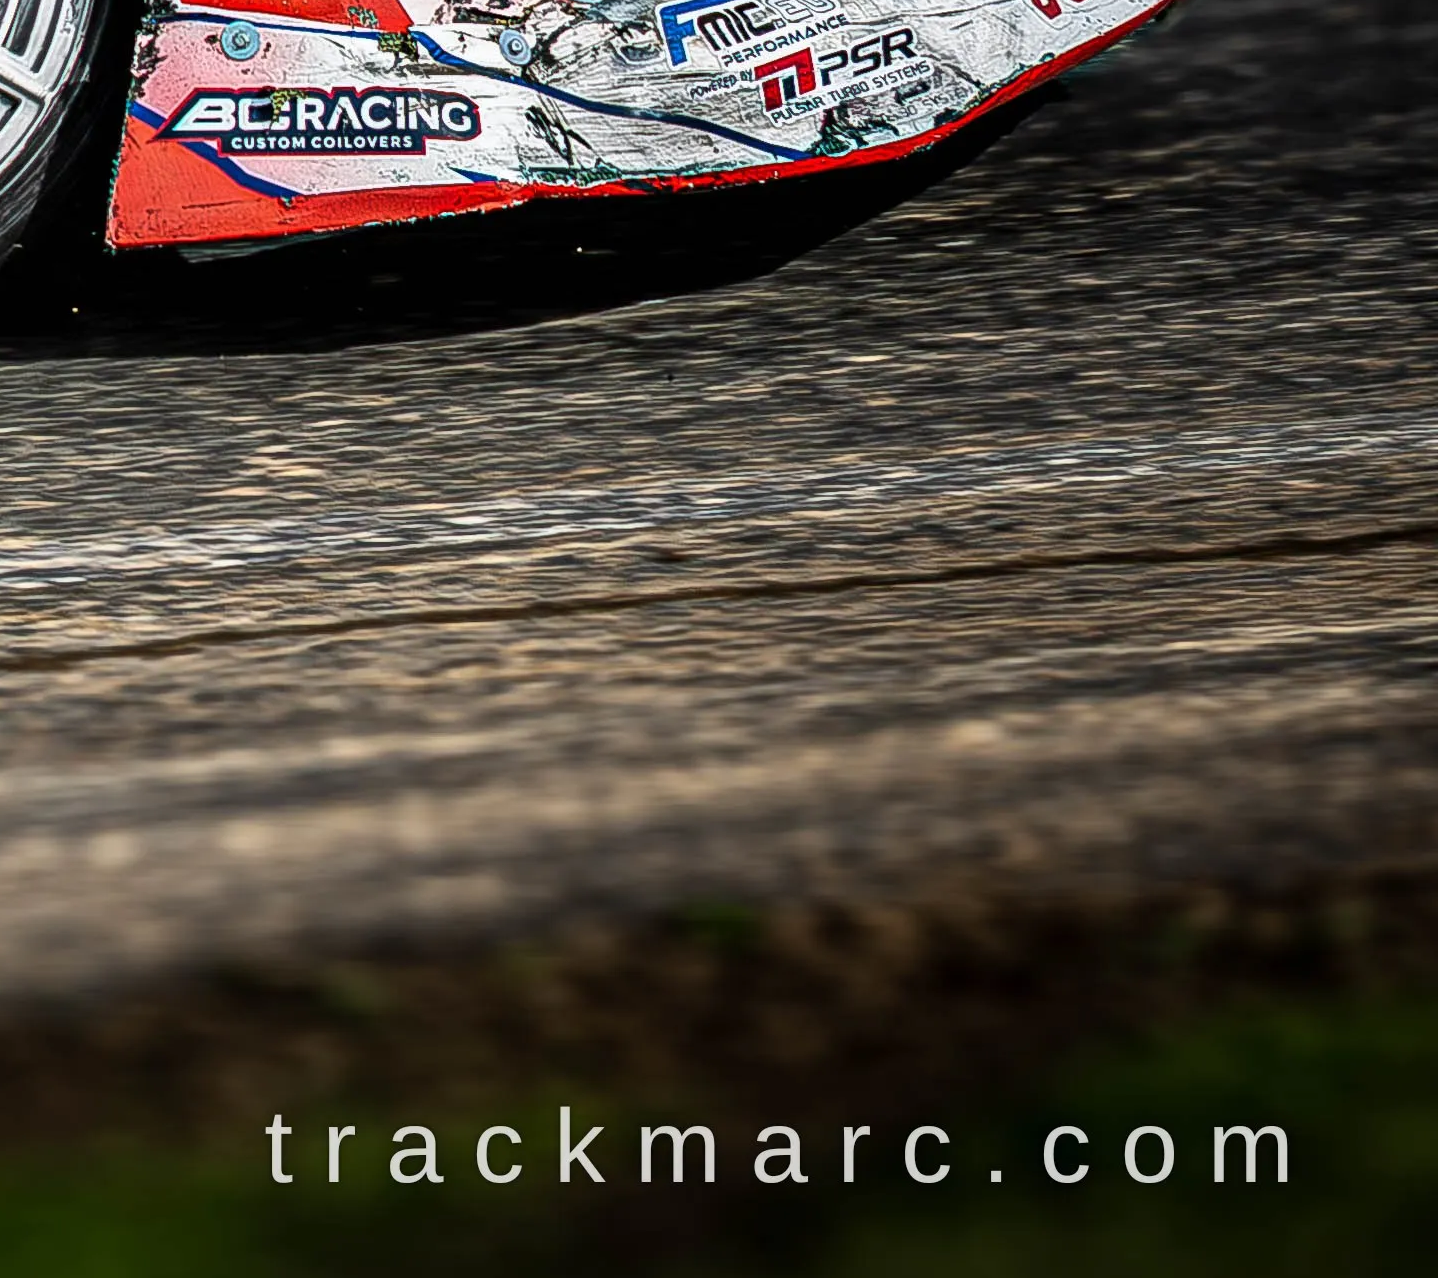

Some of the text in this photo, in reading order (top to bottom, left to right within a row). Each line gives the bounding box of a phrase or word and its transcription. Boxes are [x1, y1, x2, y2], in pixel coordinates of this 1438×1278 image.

[721, 13, 849, 68] PERFORMANCE
[690, 70, 754, 100] POWERED BY
[770, 59, 932, 124] PULSAR TURBO SYSTEMS
[292, 94, 473, 133] RACING
[231, 135, 413, 150] CUSTOM COILOVERS
